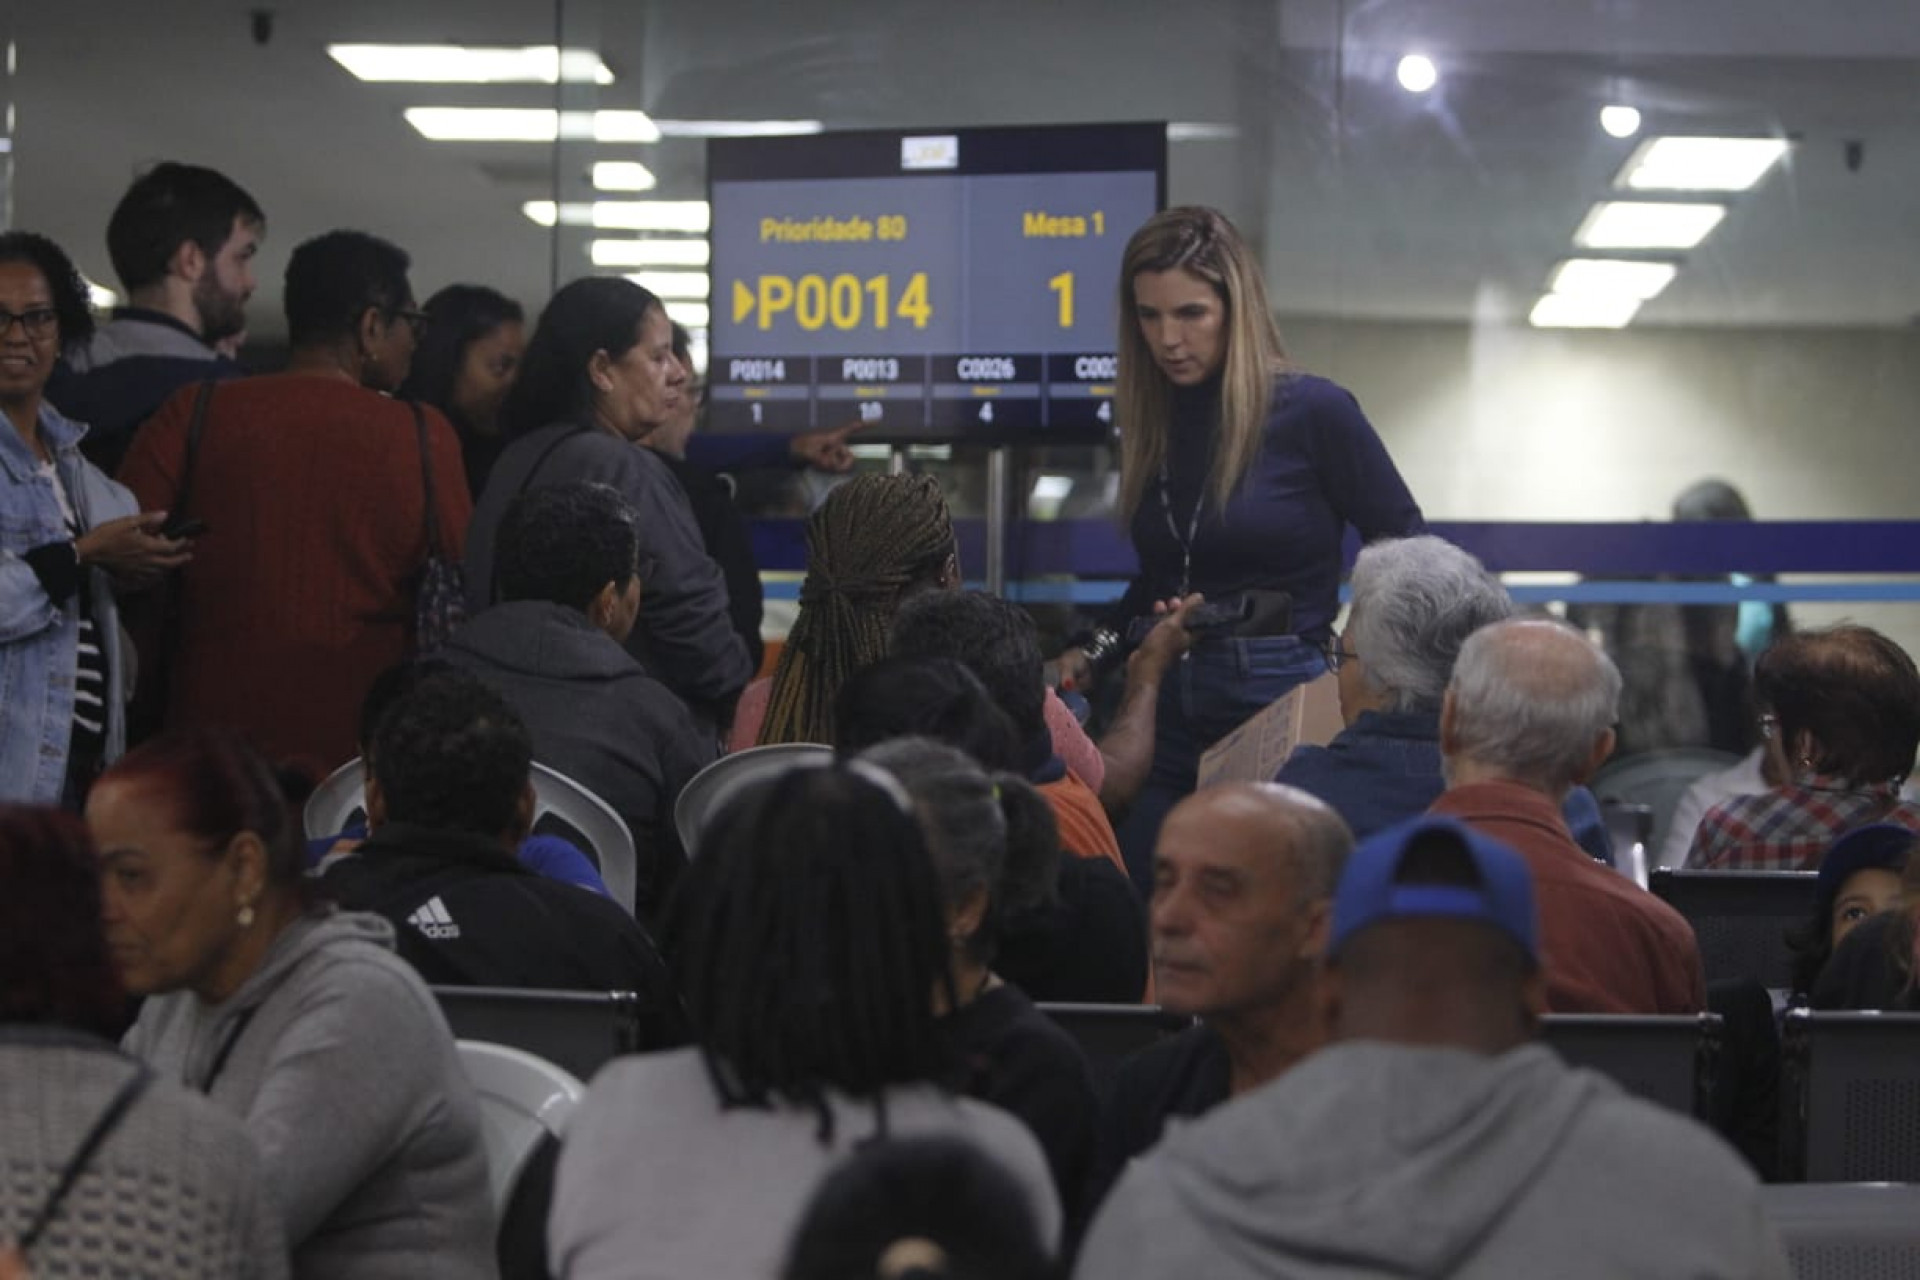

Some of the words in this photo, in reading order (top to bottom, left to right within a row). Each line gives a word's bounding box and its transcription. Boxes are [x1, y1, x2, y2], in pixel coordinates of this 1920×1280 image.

[760, 215, 873, 242] Prioridade
[1023, 212, 1086, 238] Mesa
[1092, 210, 1104, 236] 1
[757, 272, 932, 331] P0014
[1049, 271, 1074, 328] 1
[730, 359, 786, 381] P0014
[843, 358, 899, 381] P0013
[957, 357, 1016, 380] C0026
[752, 402, 763, 425] 1
[979, 401, 993, 423] 4
[1097, 401, 1111, 423] 4
